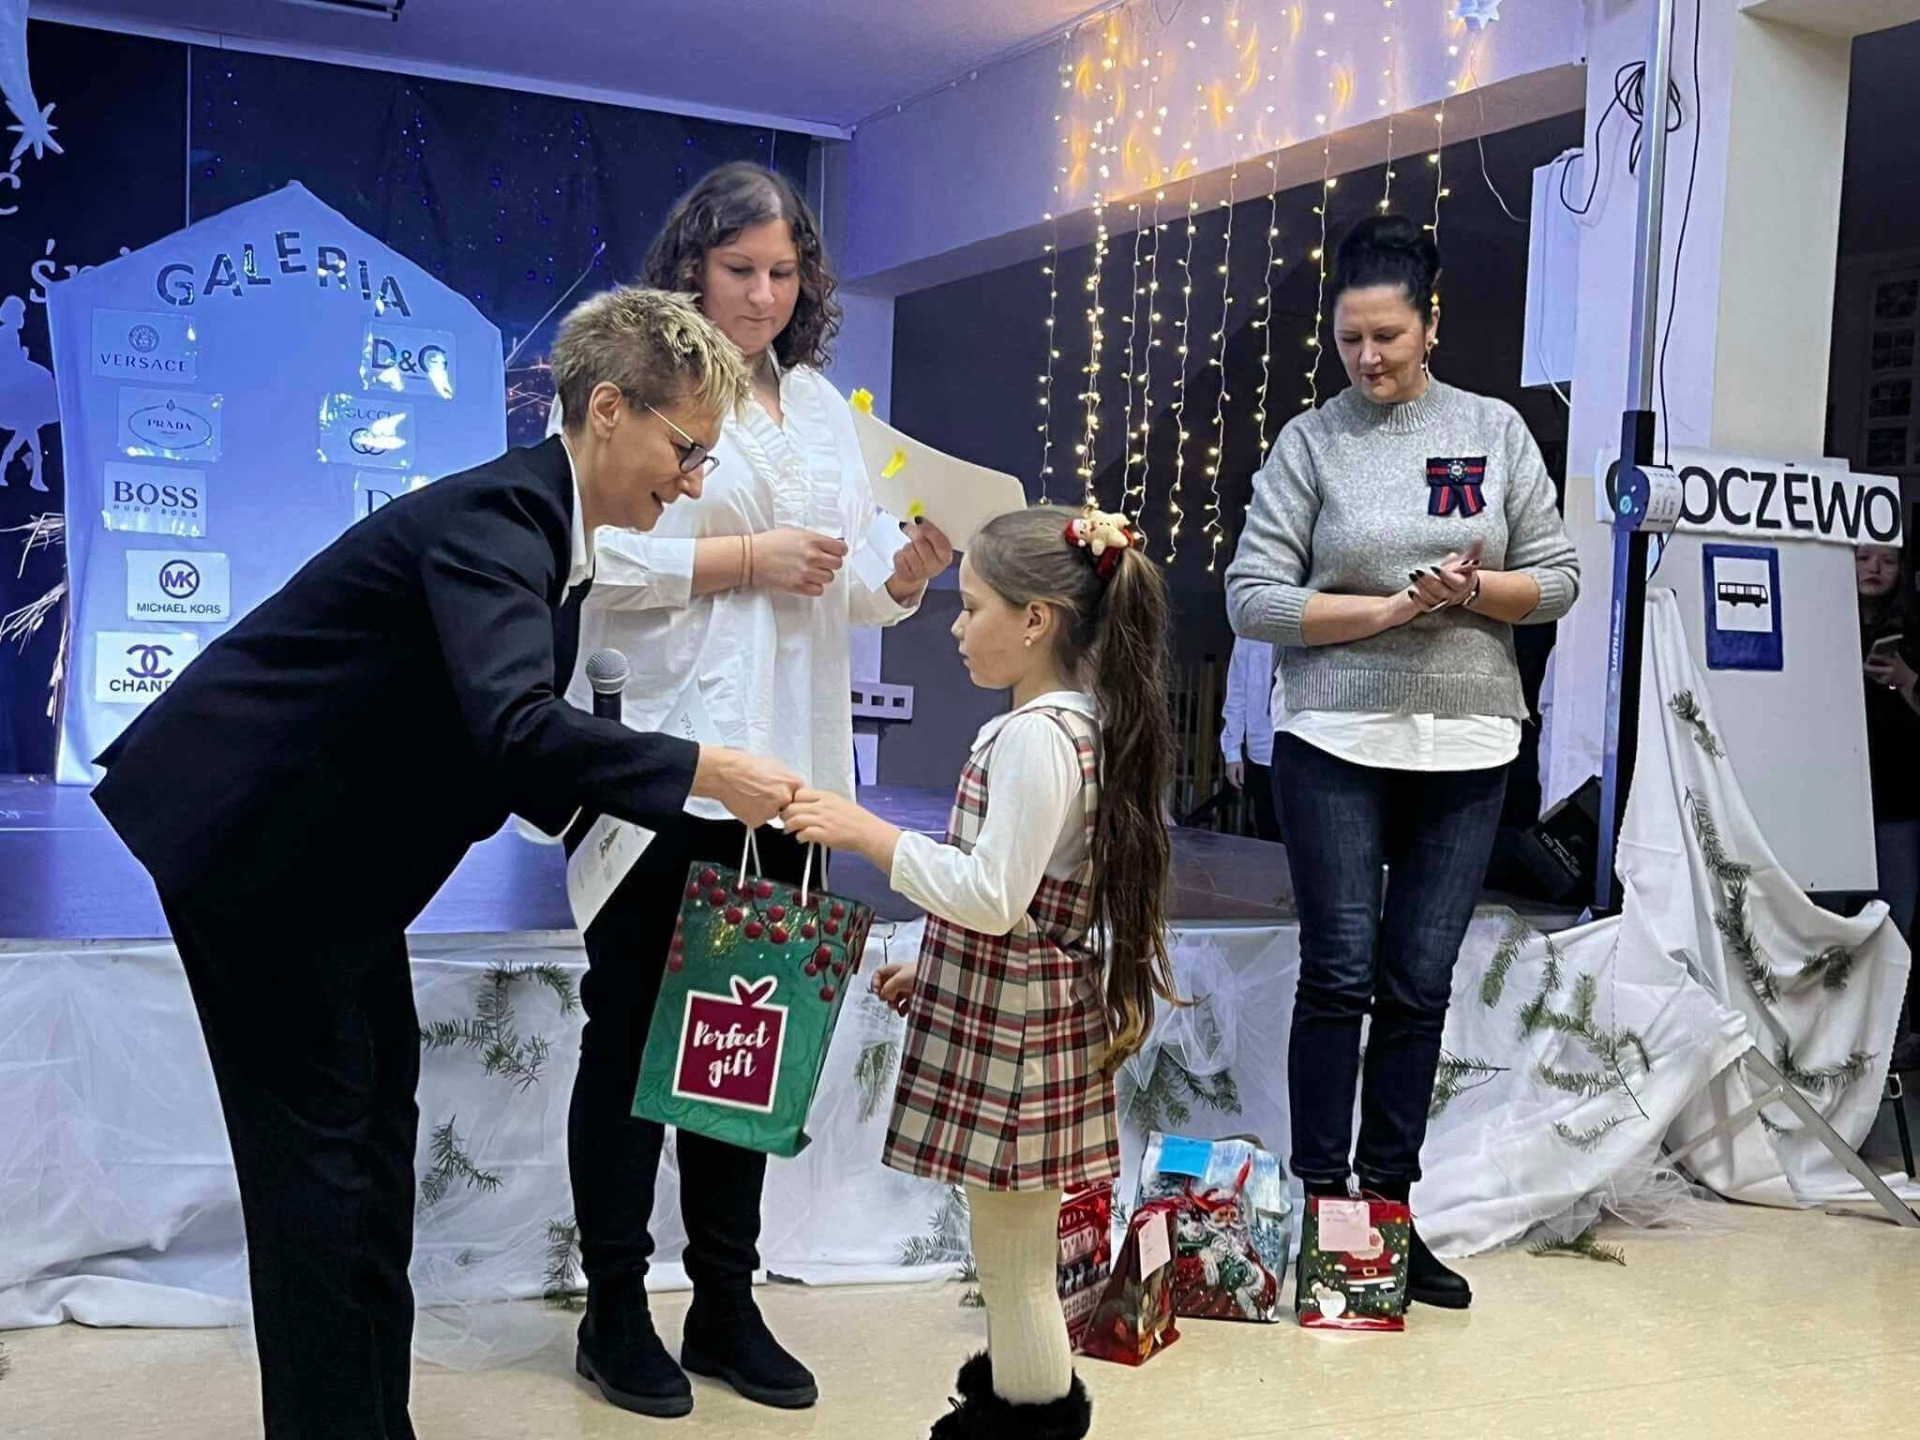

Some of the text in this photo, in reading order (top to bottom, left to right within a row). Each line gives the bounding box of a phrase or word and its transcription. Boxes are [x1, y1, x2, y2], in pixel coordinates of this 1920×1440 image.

[157, 231, 411, 317] GALERIA
[100, 353, 188, 373] VERSACE
[148, 419, 192, 431] PRADA
[346, 407, 391, 421] GUCCI
[114, 480, 198, 509] BOSS
[1605, 459, 1900, 542] OCZEWO
[164, 570, 194, 589] MK
[137, 603, 221, 615] MICHAEL KORS
[693, 1020, 770, 1050] Perfect
[708, 1048, 757, 1088] gift
